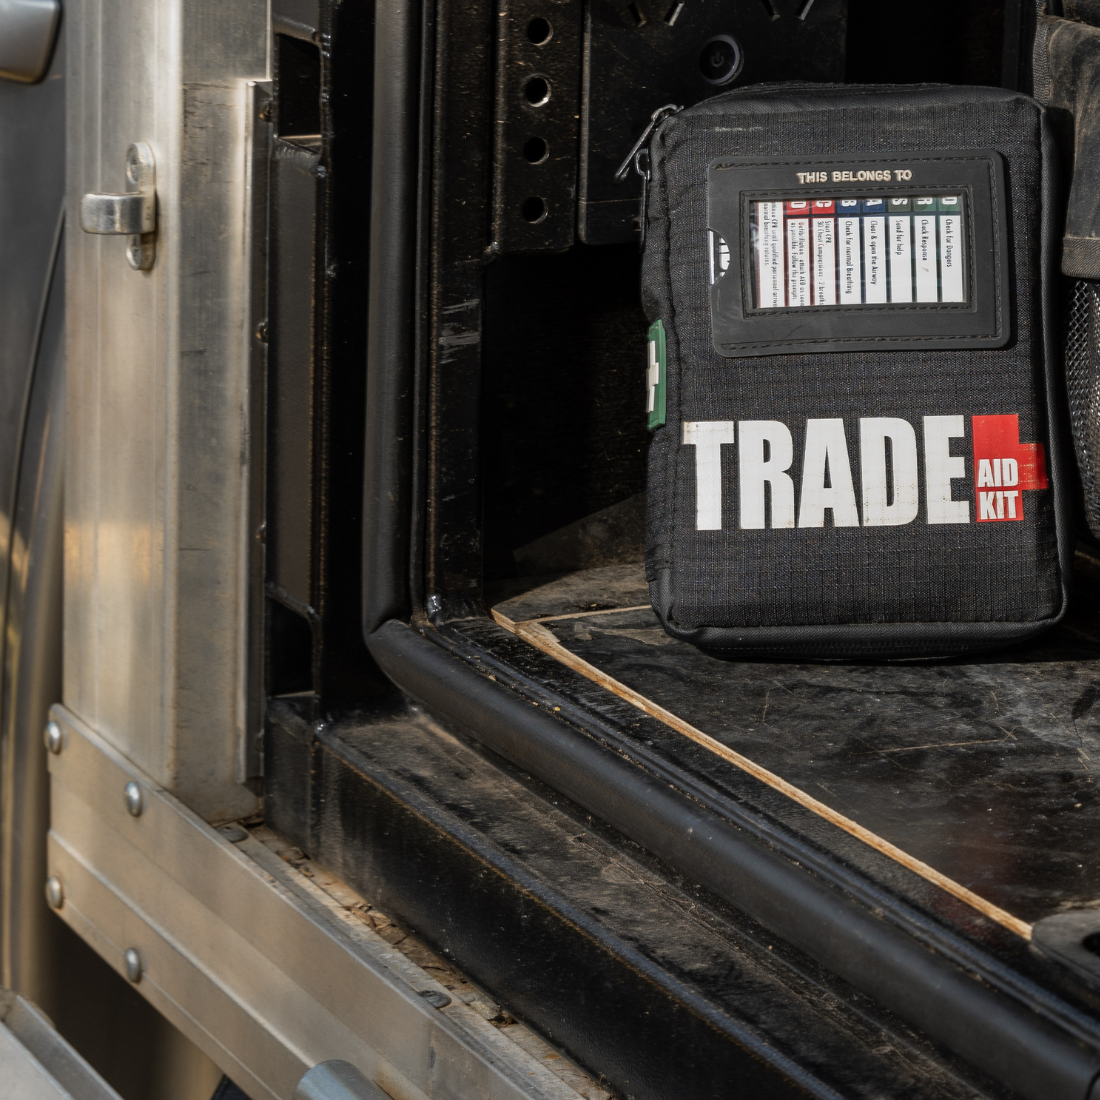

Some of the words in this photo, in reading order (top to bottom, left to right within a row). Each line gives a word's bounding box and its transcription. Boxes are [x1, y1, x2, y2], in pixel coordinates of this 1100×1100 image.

[796, 171, 828, 185] THIS
[832, 170, 892, 183] BELONGS
[894, 169, 913, 182] TO
[763, 222, 771, 247] breathing
[824, 221, 832, 234] Start
[845, 220, 853, 236] Check
[870, 220, 878, 234] Clear
[896, 220, 904, 234] Send
[921, 220, 929, 235] Check
[945, 219, 953, 235] Check
[798, 222, 806, 256] Defibrillation
[869, 241, 877, 255] open
[920, 236, 929, 261] Response
[771, 243, 780, 266] qualified
[846, 247, 854, 267] normal
[895, 243, 904, 256] help
[944, 244, 954, 268] Dangers
[817, 244, 825, 277] Compressions
[871, 256, 879, 265] the
[771, 266, 780, 291] personnel
[845, 267, 854, 295] Breathing
[870, 266, 879, 285] Airway
[683, 414, 970, 531] TRADE
[977, 458, 1019, 488] AID
[978, 490, 1019, 521] KIT
